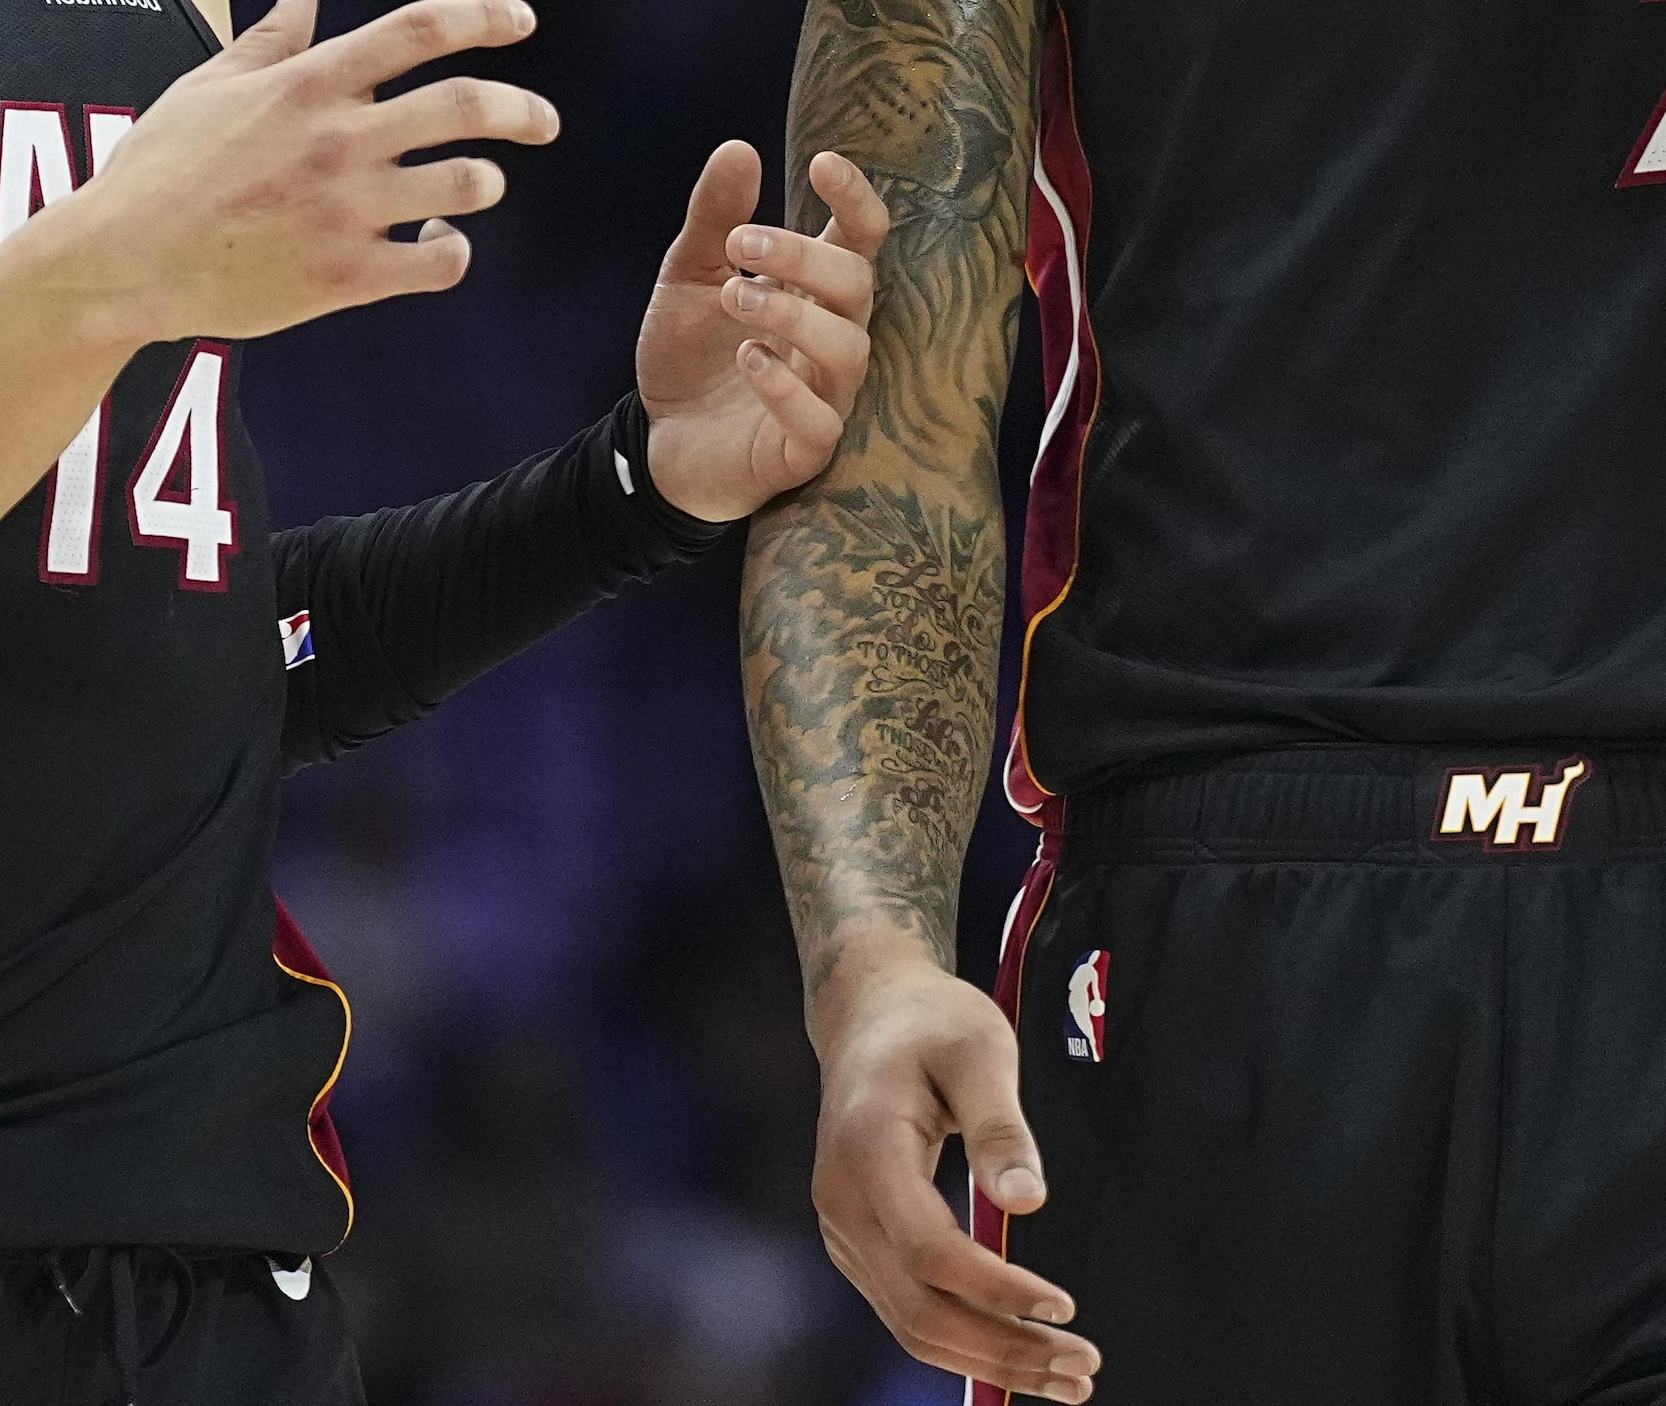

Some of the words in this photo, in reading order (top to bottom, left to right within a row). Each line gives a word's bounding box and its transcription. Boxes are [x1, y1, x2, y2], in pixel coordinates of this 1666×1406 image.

[39, 339, 240, 593] 14
[1436, 757, 1587, 846] MH
[1067, 1037, 1089, 1057] NBA
